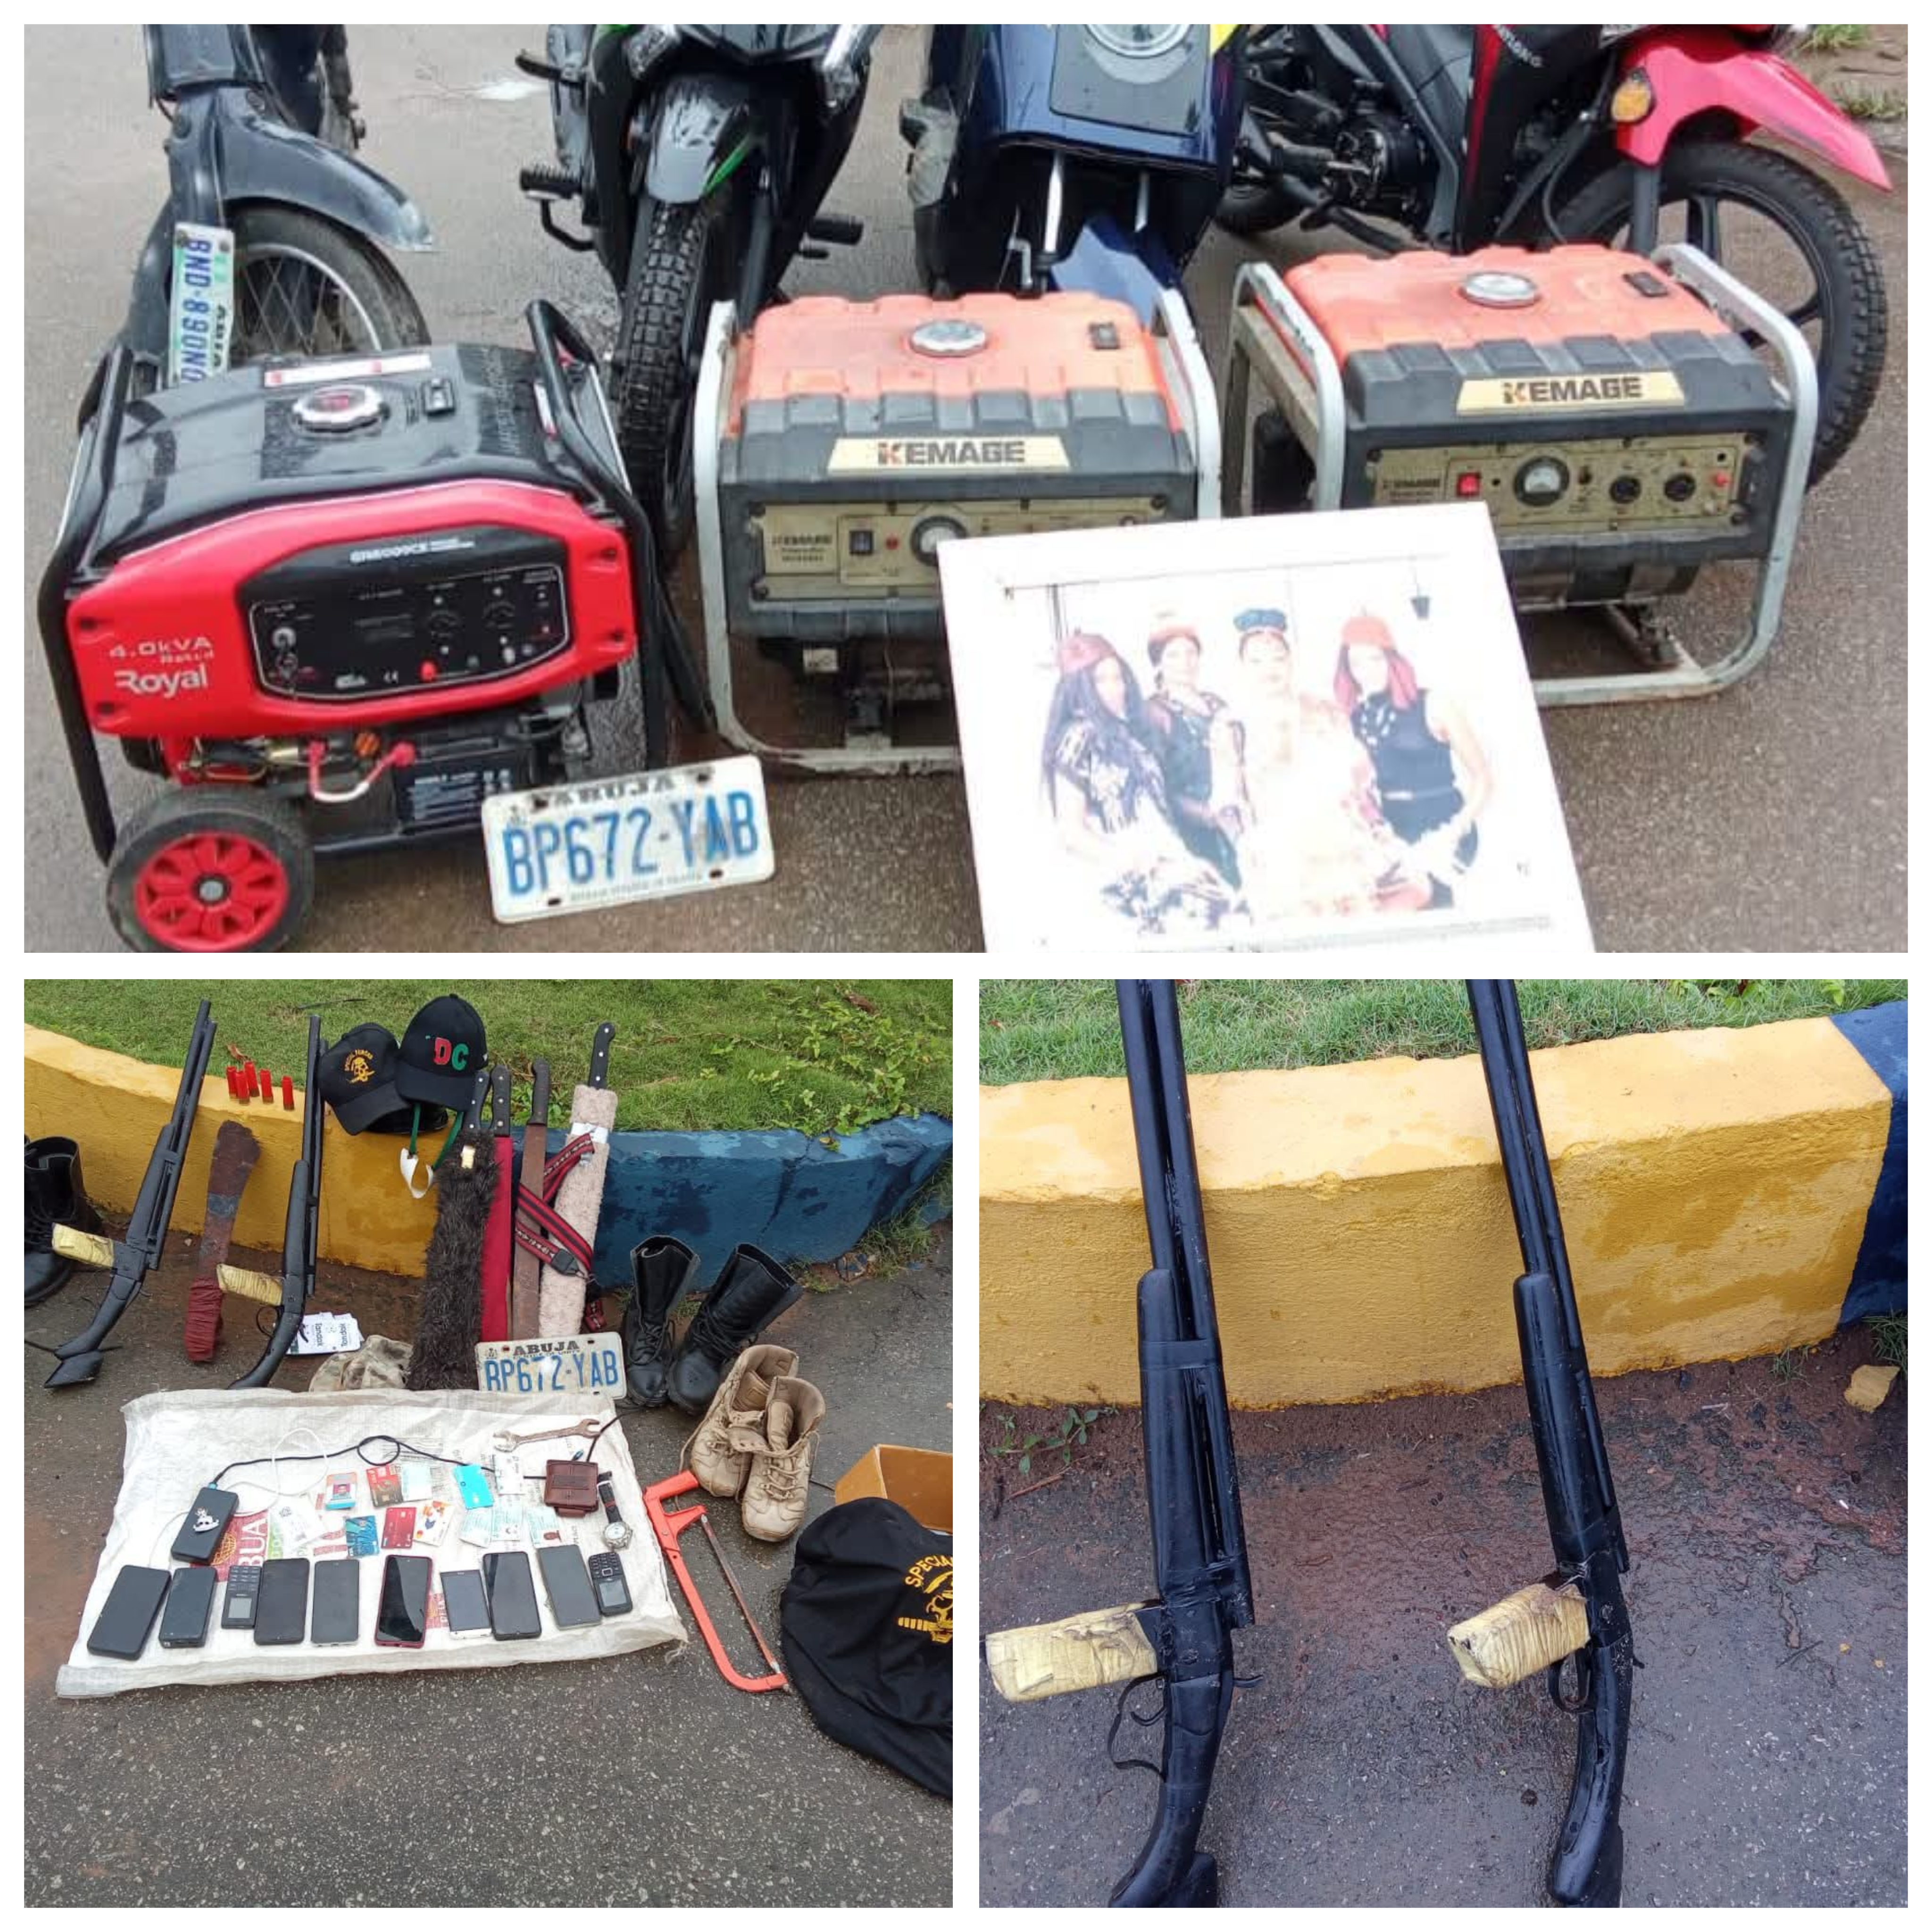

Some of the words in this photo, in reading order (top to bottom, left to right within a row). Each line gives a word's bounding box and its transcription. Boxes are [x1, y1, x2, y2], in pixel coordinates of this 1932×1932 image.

[1502, 376, 1642, 403] KEMAGE
[877, 441, 1025, 465] KEMAGE
[114, 662, 208, 699] Royal
[502, 789, 759, 897] BP672-YAB
[433, 1037, 469, 1071] DC
[513, 1340, 580, 1356] ABUJA
[238, 1517, 268, 1566] BUA
[905, 1555, 953, 1588] SPECIA
